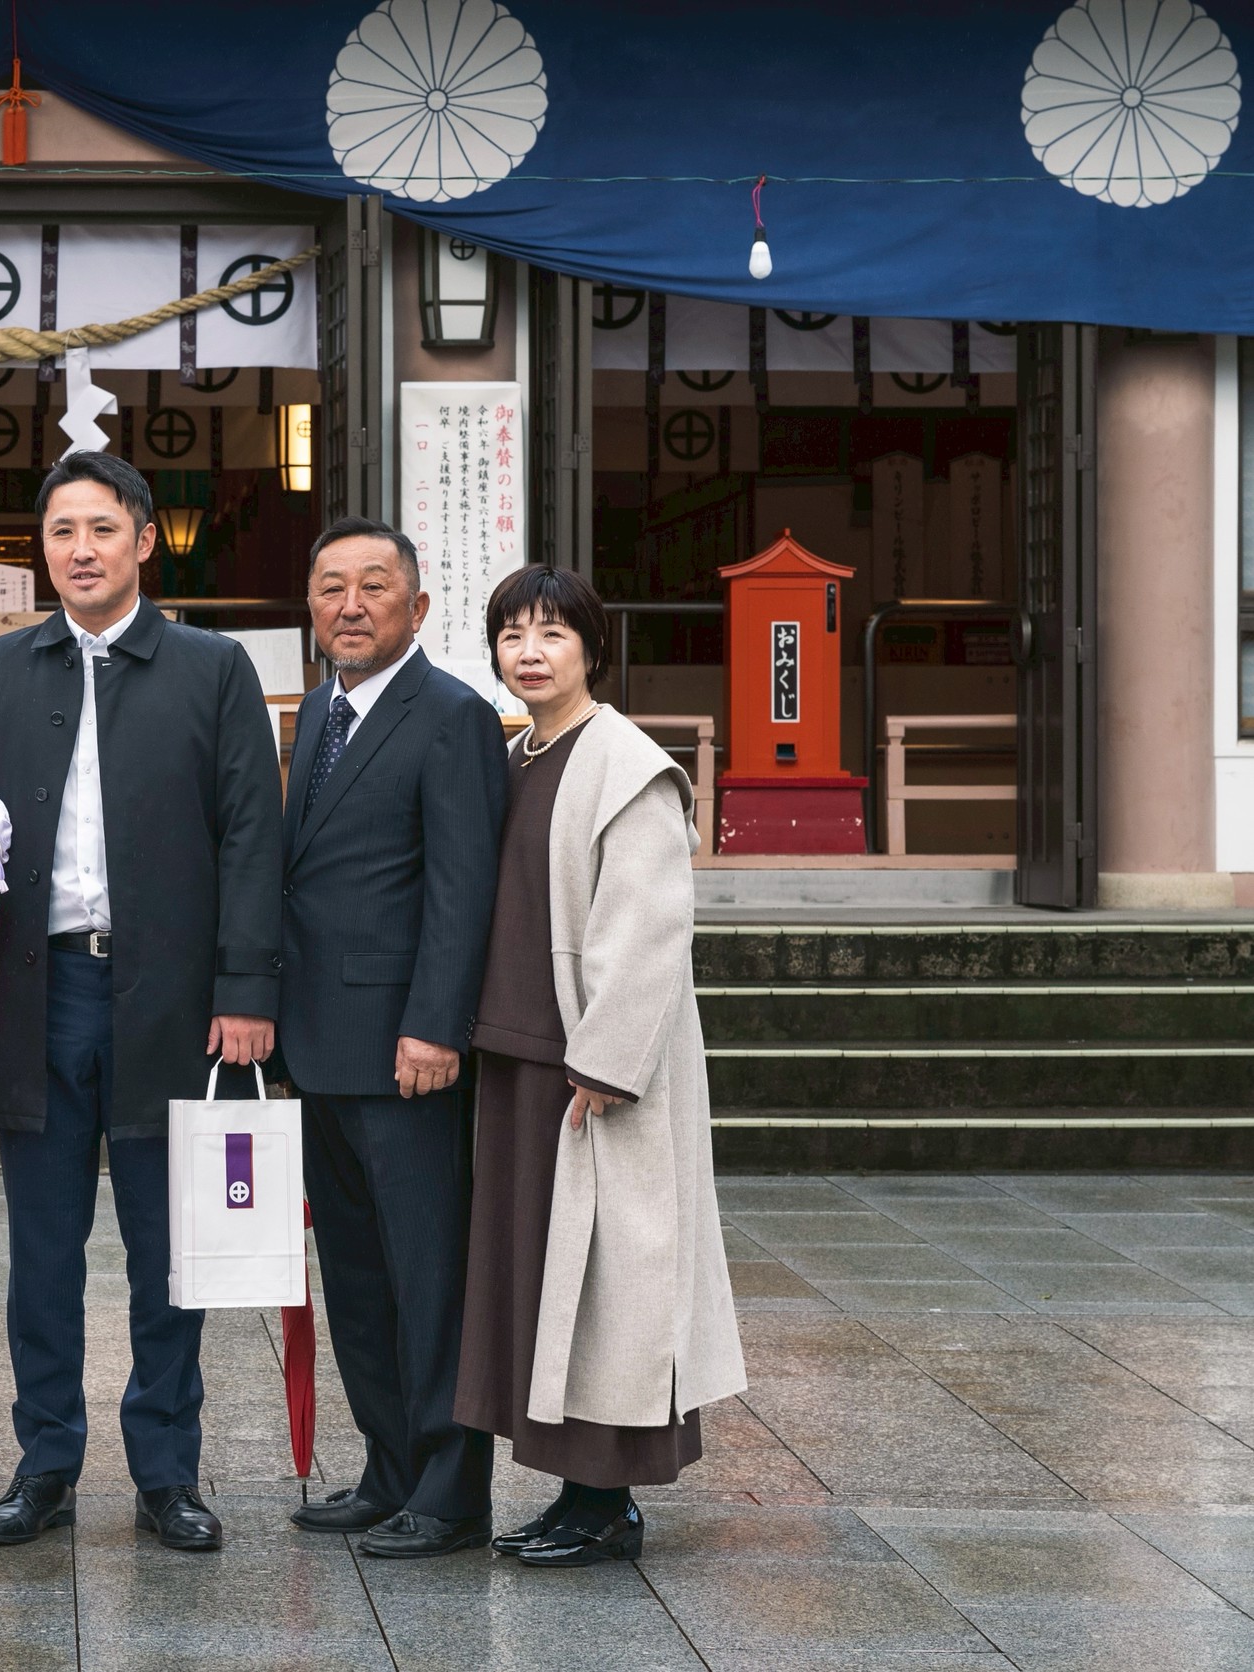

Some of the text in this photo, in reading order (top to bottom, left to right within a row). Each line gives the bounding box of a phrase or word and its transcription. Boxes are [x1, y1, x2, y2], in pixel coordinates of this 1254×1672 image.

[439, 406, 450, 428] 何卒
[477, 404, 490, 450] 令和六年
[458, 406, 471, 631] 境内整備事業を実施することとなりました
[495, 404, 515, 553] 御奉賛のお願い
[775, 627, 796, 718] おみくじ
